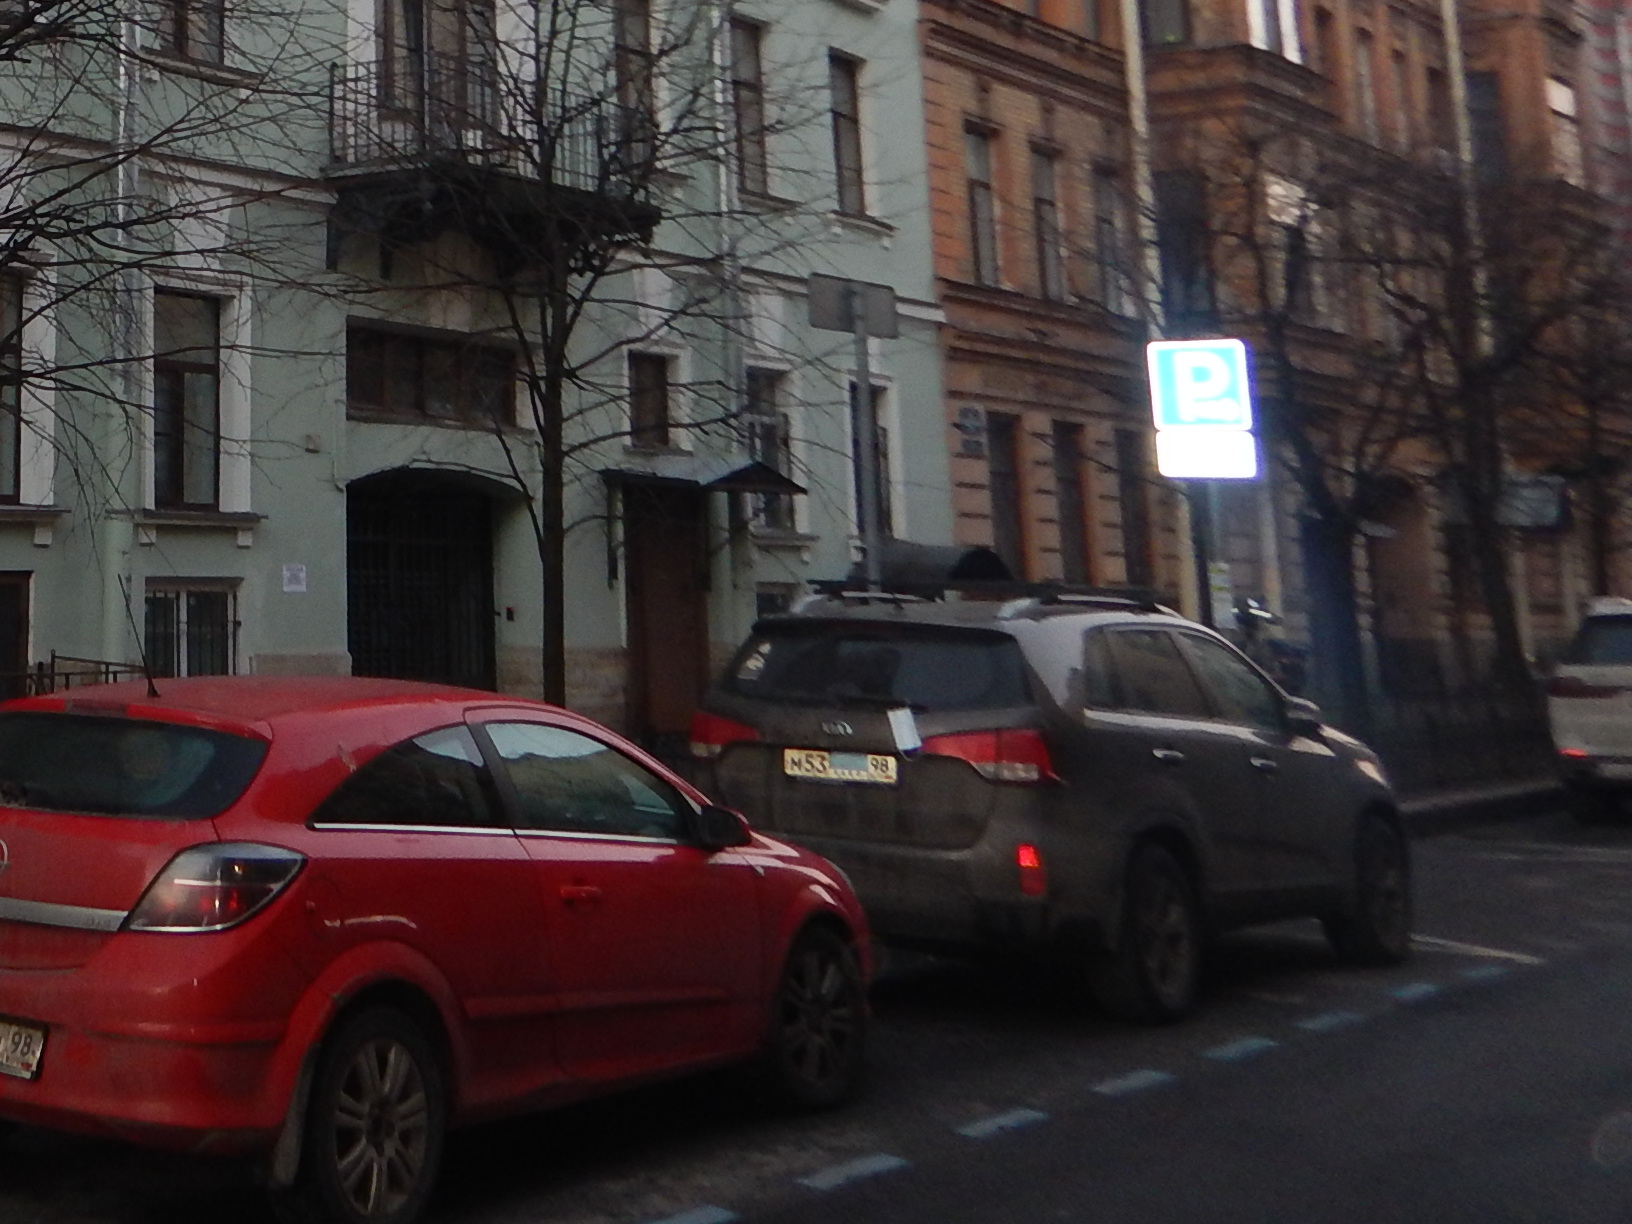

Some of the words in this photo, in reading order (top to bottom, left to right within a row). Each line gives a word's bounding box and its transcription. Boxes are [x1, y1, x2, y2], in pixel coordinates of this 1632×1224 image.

[1174, 350, 1230, 422] P
[870, 756, 889, 774] 98
[11, 1030, 33, 1057] 98
